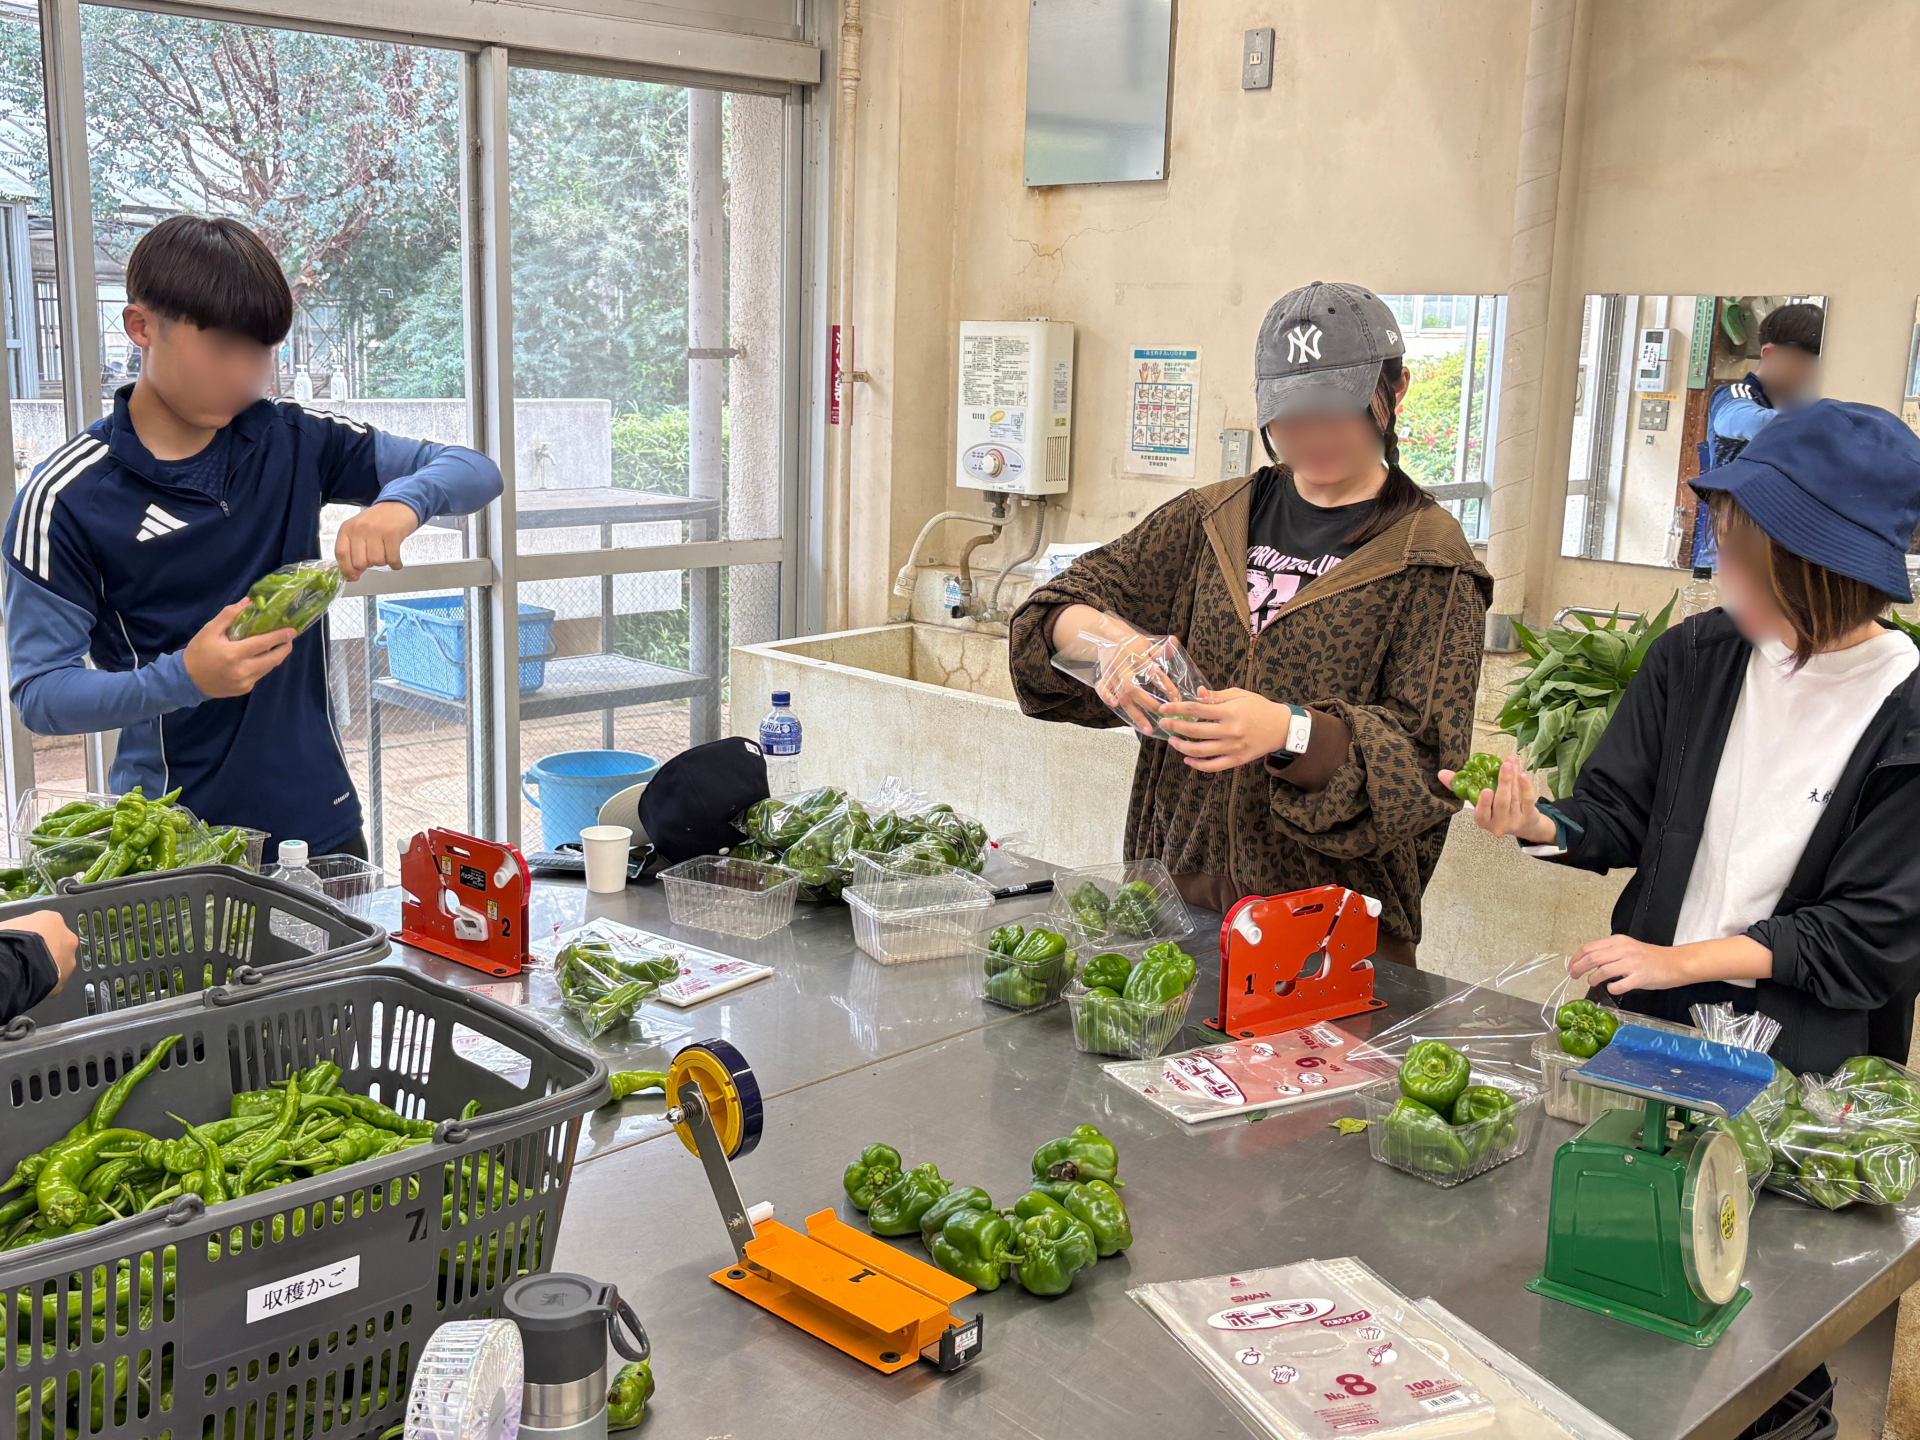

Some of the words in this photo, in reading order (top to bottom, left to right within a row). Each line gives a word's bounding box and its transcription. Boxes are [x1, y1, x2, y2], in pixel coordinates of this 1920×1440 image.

[1287, 323, 1323, 364] NY
[501, 918, 510, 938] 2
[1244, 973, 1255, 996] 1
[1162, 1071, 1191, 1092] SWAN
[262, 1267, 347, 1310] 収穫かご
[1230, 1291, 1272, 1303] SWAN
[1223, 1301, 1317, 1328] ボードン
[1323, 1311, 1367, 1326] 穴ありタイプ
